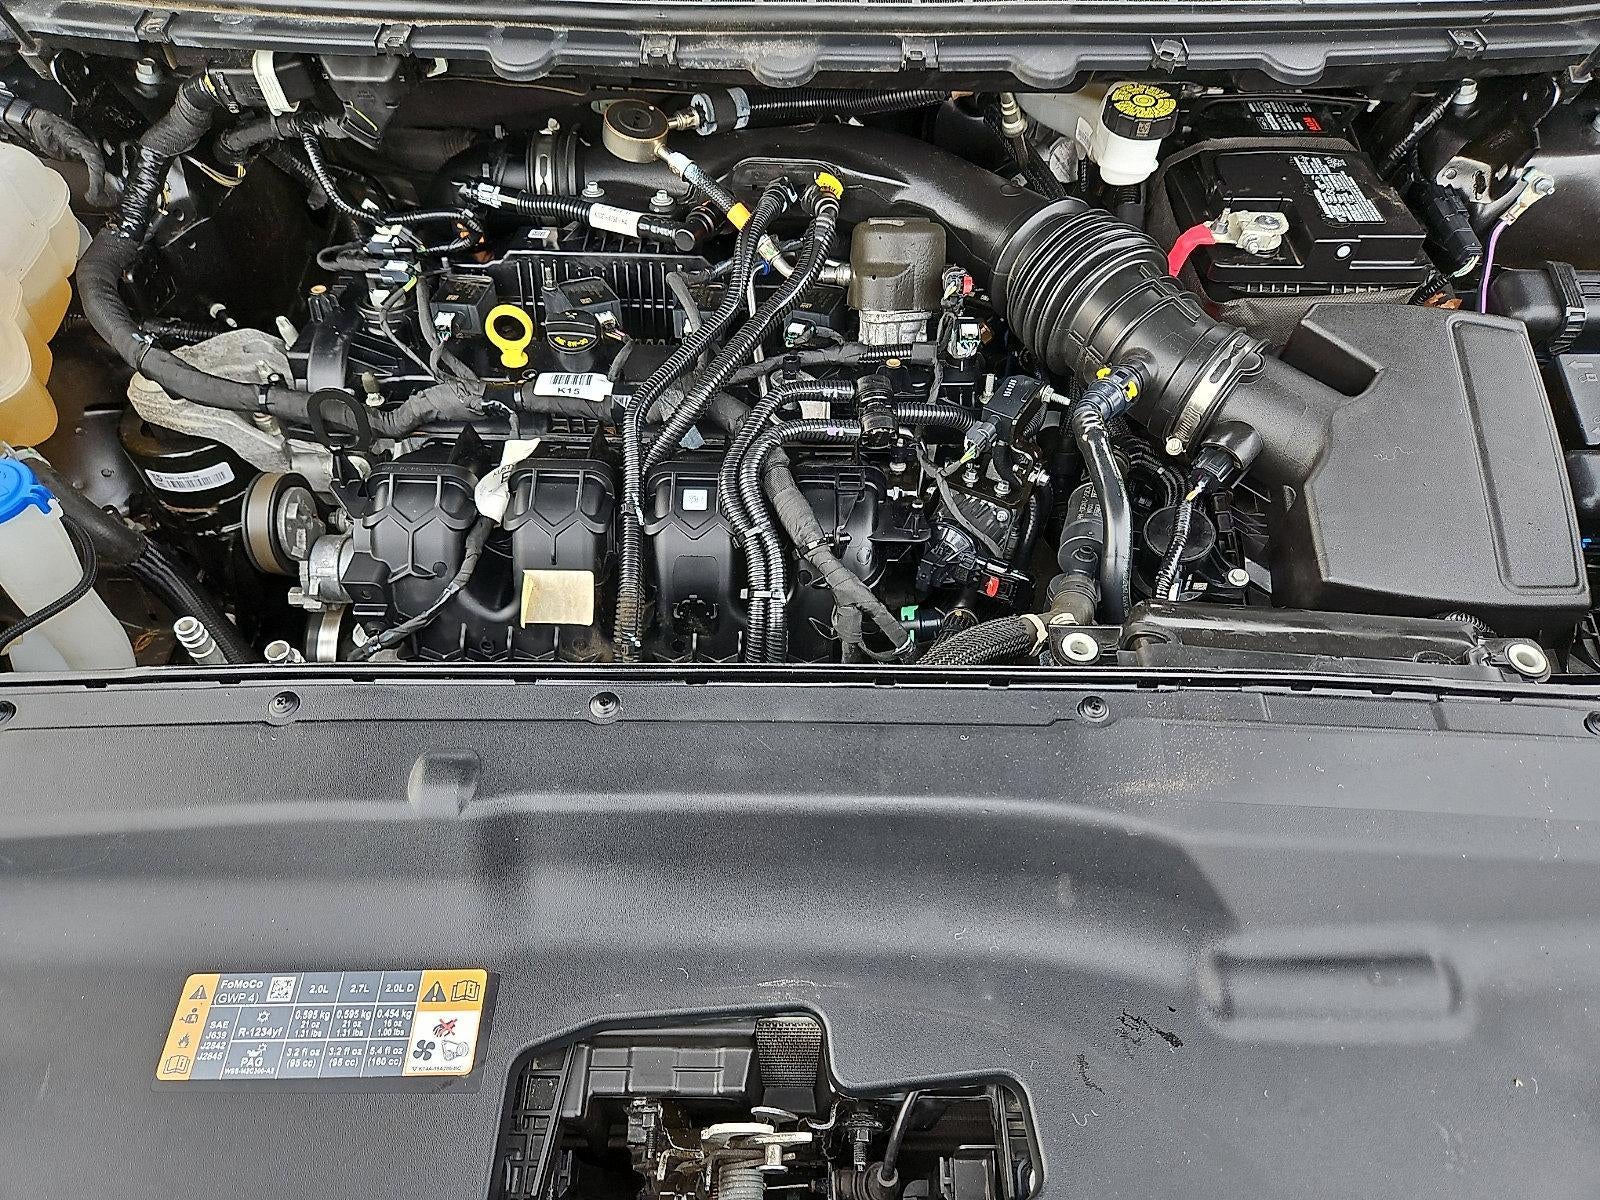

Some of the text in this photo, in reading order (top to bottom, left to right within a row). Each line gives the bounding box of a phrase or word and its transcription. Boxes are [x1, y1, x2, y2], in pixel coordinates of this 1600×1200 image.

[557, 387, 580, 395] K15
[220, 979, 264, 989] FoMoCo
[308, 984, 329, 994] 2.0L
[350, 984, 370, 994] 2.7L
[386, 984, 414, 993] 2.0L D
[214, 992, 260, 1006] (GWP 4)
[320, 1010, 330, 1021] kg
[361, 1009, 372, 1021] kg
[377, 1008, 412, 1020] 0.454 kg
[210, 1020, 230, 1029] SAE
[238, 1027, 284, 1039] R-1234yf
[286, 1047, 300, 1056] 3.2
[310, 1048, 320, 1056] oz
[328, 1046, 342, 1056] 3.2
[352, 1048, 362, 1056] oz
[393, 1047, 404, 1055] oz
[240, 1057, 264, 1068] PAG
[302, 1058, 316, 1068] cc)
[344, 1058, 358, 1068] cc)
[388, 1057, 402, 1067] cc)
